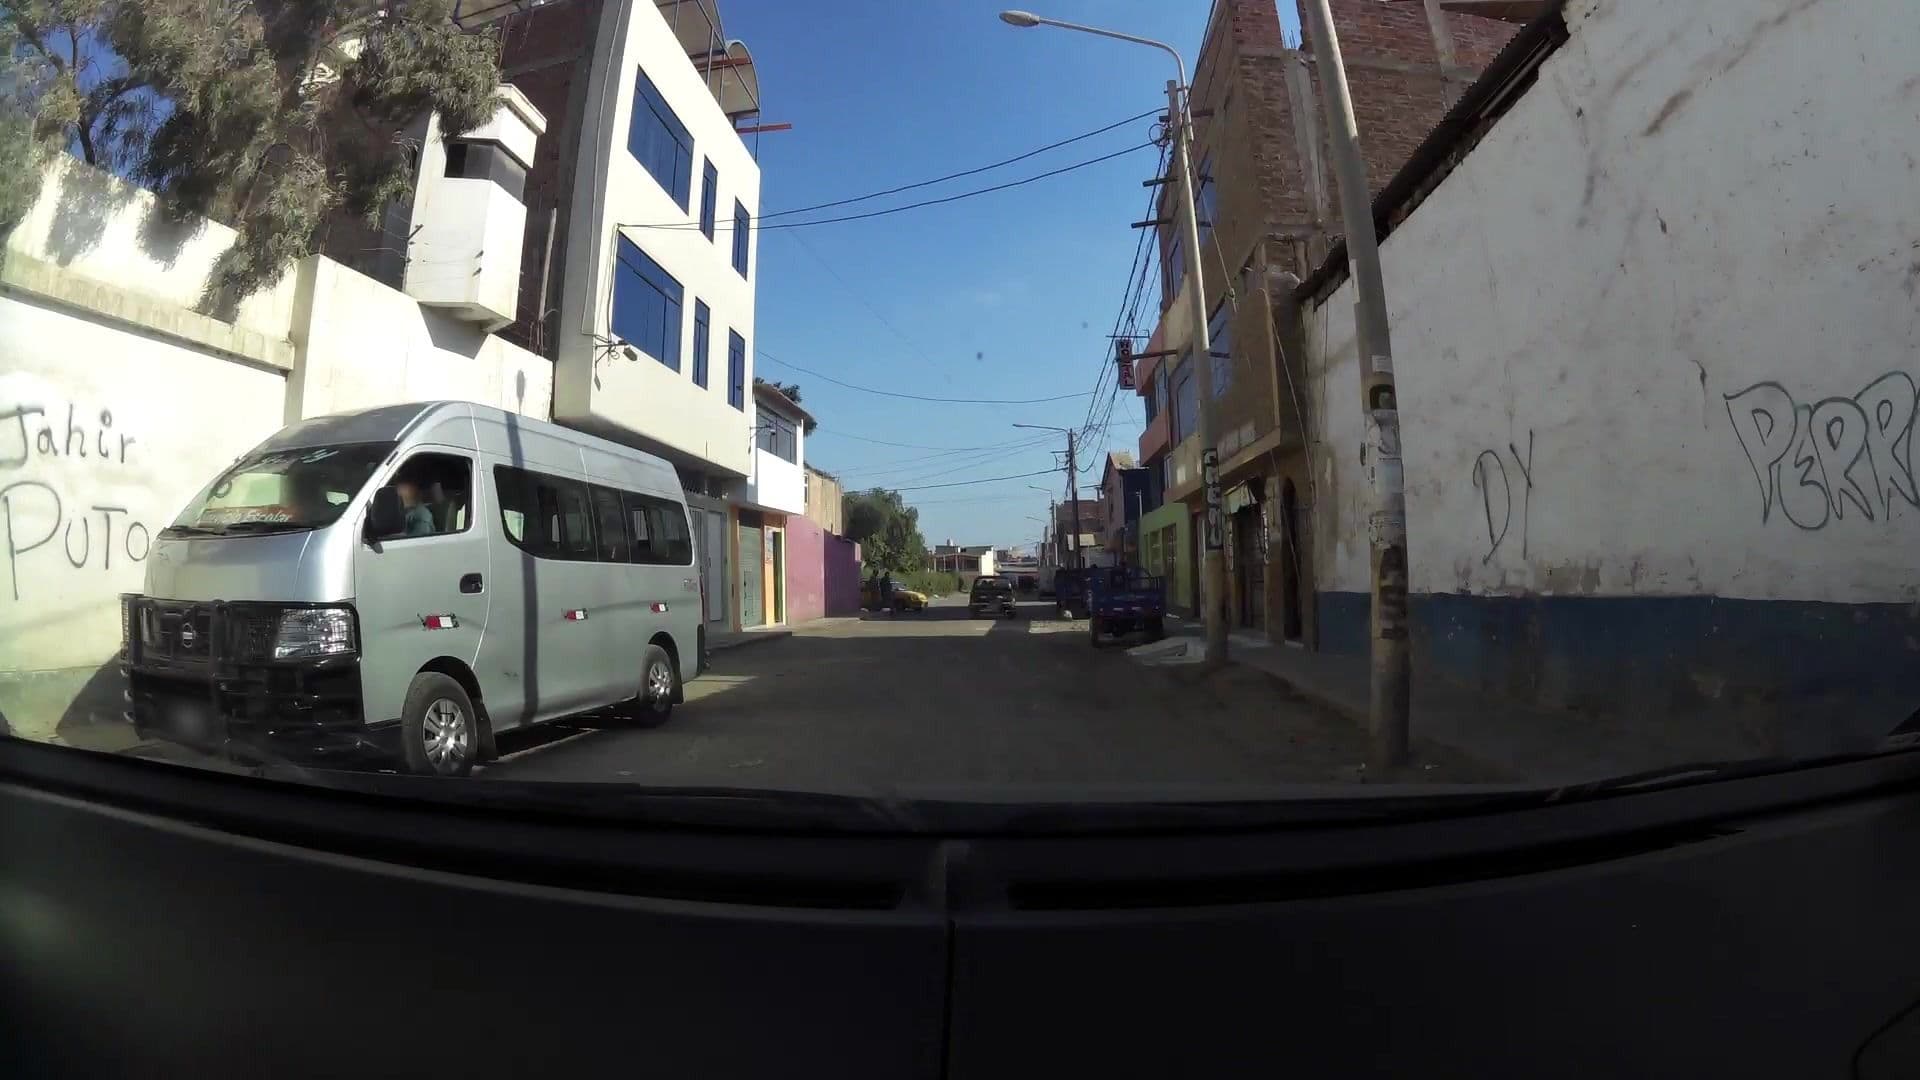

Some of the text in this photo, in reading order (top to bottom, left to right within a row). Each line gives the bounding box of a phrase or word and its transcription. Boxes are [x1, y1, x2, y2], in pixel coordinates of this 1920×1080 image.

[0, 403, 137, 469] Jahir
[1722, 370, 1920, 530] PERR
[1, 480, 150, 601] PUTO
